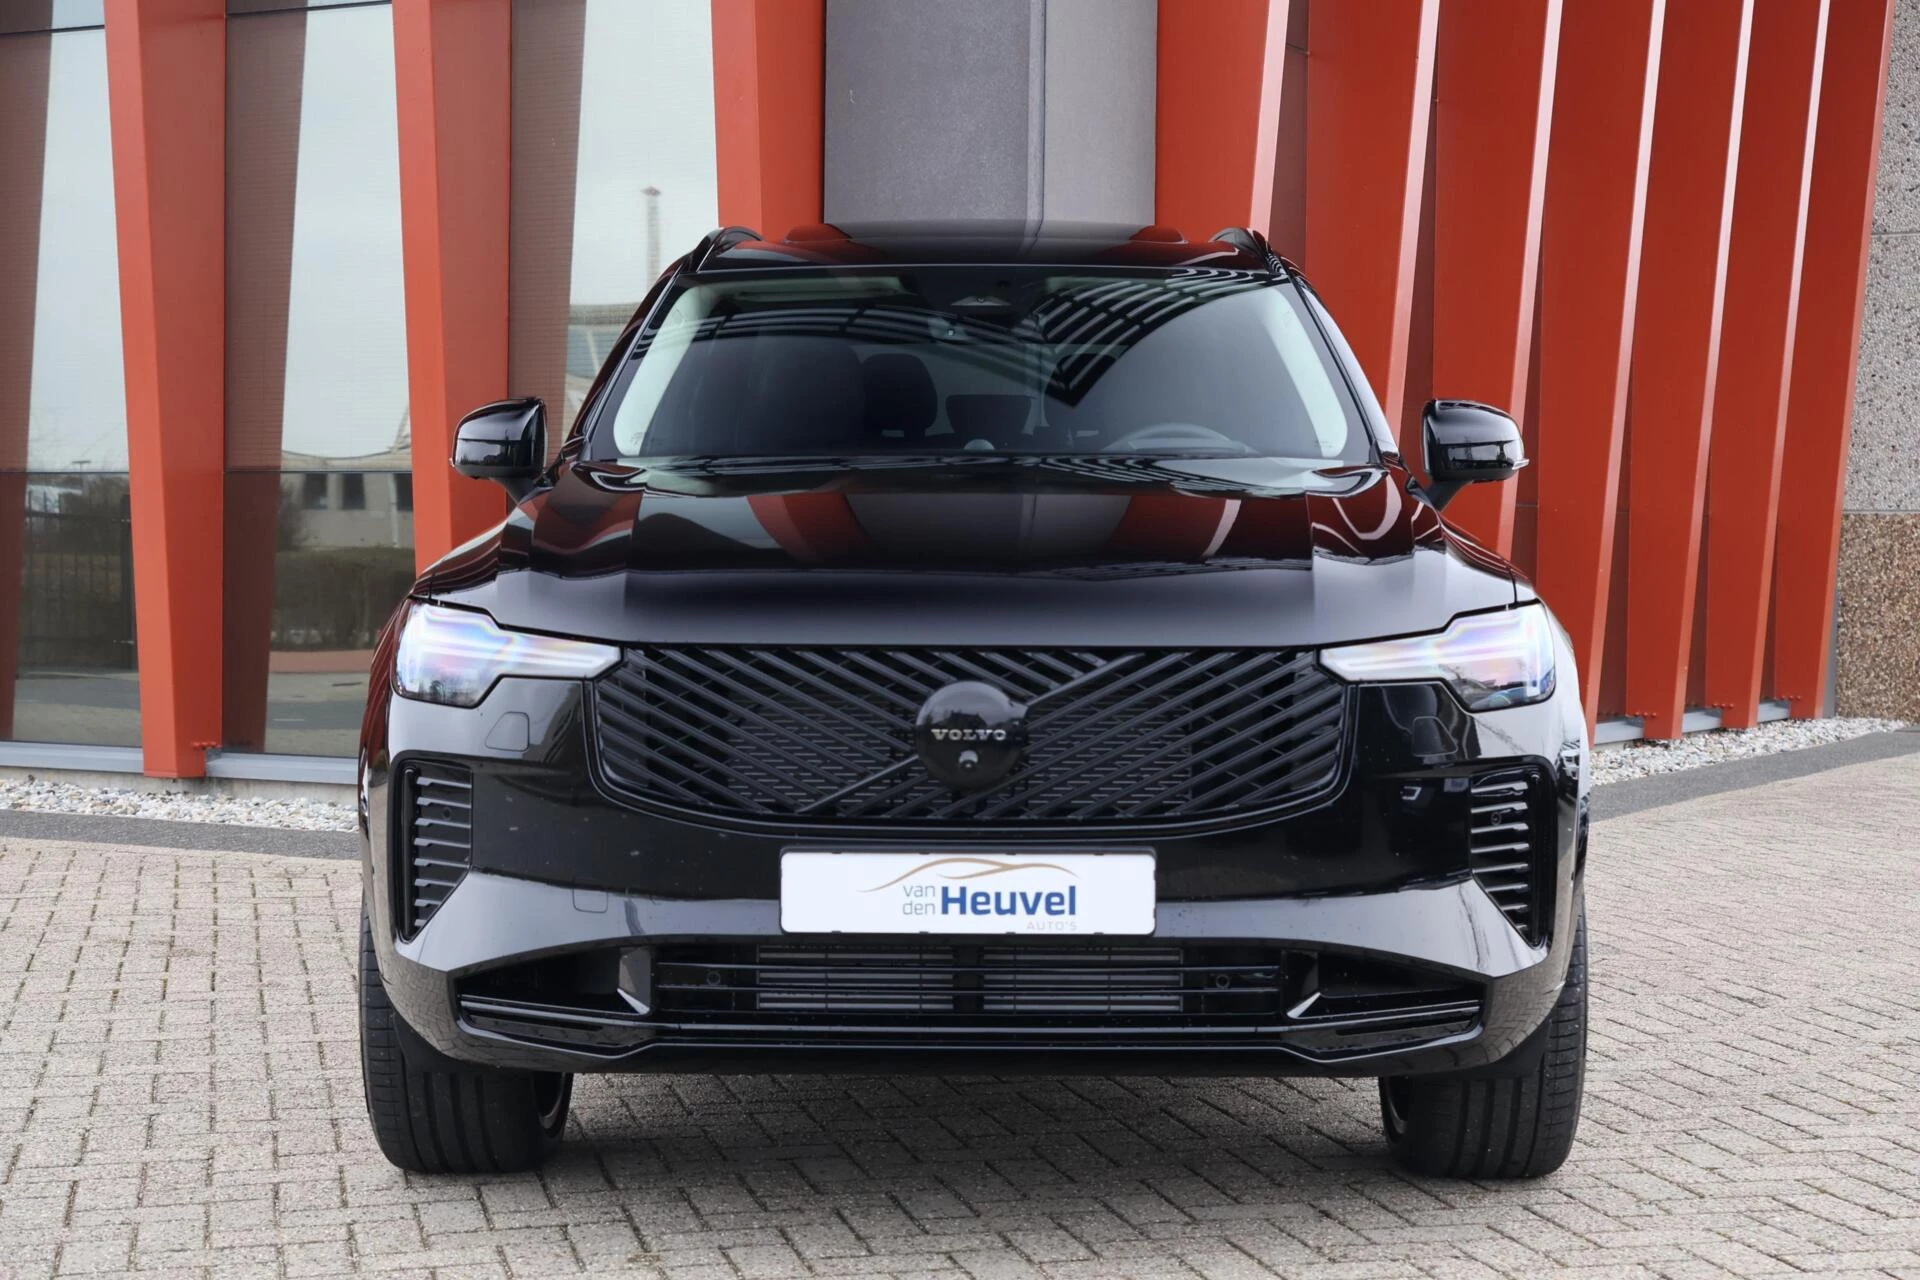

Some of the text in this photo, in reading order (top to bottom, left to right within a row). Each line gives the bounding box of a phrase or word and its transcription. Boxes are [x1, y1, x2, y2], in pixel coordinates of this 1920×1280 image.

[931, 729, 1007, 741] VOLVO
[902, 885, 936, 898] van
[902, 885, 1076, 916] den Heuvel
[1026, 921, 1077, 931] AUTO'S
